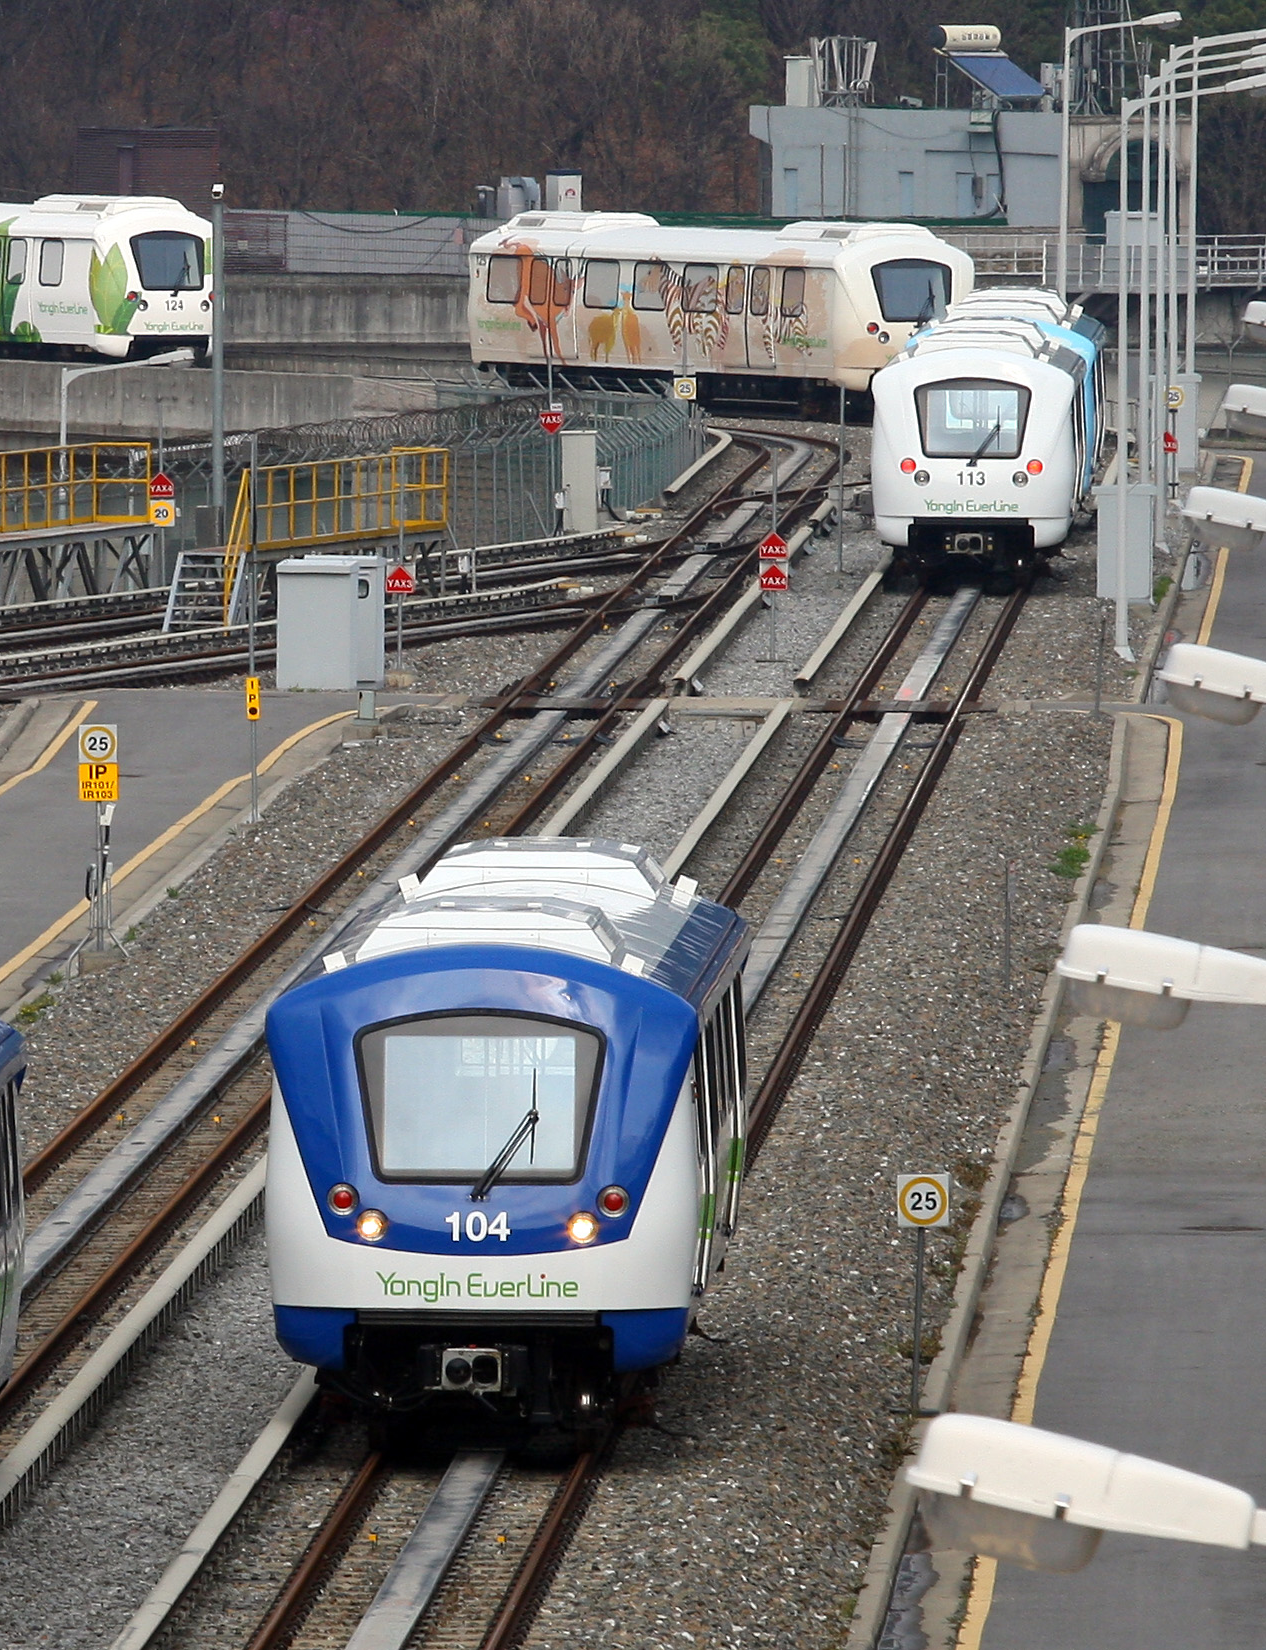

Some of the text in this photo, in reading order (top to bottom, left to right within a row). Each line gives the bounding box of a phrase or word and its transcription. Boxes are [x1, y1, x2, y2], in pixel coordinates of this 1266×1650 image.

[164, 299, 183, 311] 124
[679, 384, 691, 393] 25
[956, 471, 986, 486] 113
[154, 508, 169, 518] 20
[924, 499, 1019, 514] YongIn EverLine
[387, 579, 413, 589] YAX3
[88, 736, 109, 751] 25
[88, 764, 108, 780] IP
[83, 790, 113, 799] IR103
[910, 1191, 937, 1211] 25
[445, 1210, 512, 1243] 104
[375, 1271, 579, 1303] YongIn EverLine
